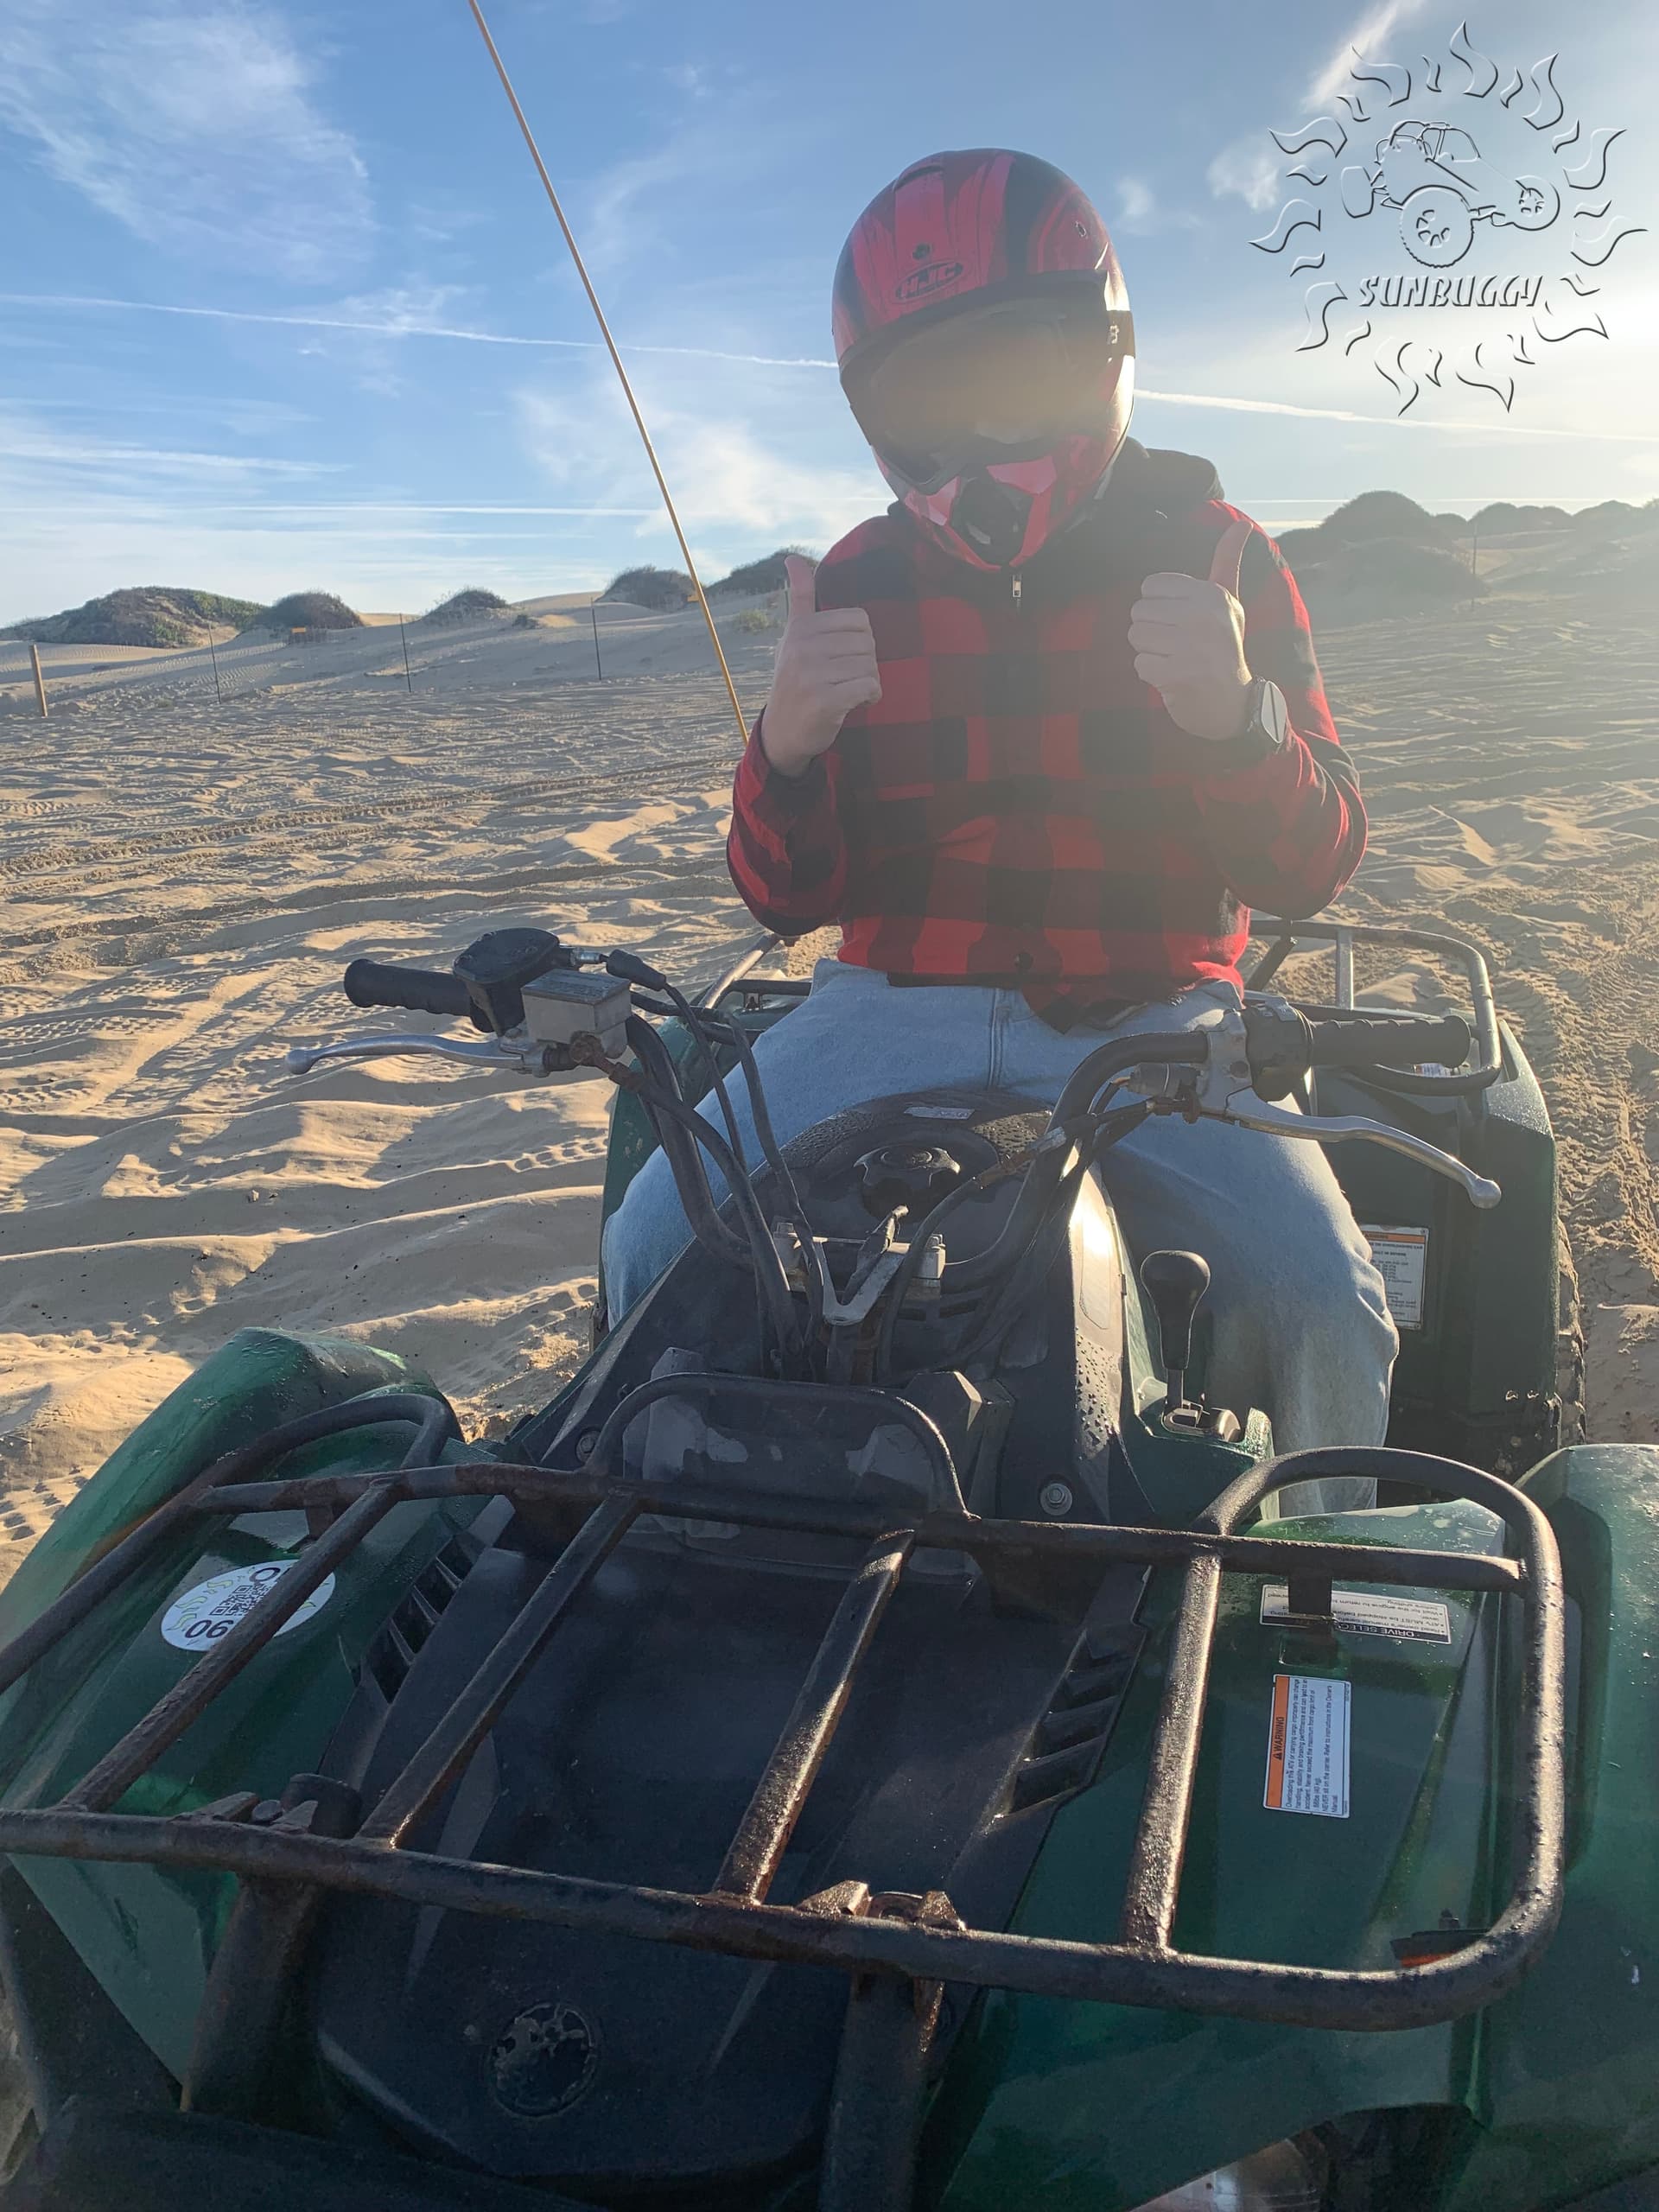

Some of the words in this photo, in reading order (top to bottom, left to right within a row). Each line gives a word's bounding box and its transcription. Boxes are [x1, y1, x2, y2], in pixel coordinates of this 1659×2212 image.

[899, 262, 957, 299] HJC
[1381, 1628, 1414, 1637] DRIVE
[1274, 1716, 1284, 1751] WARNING
